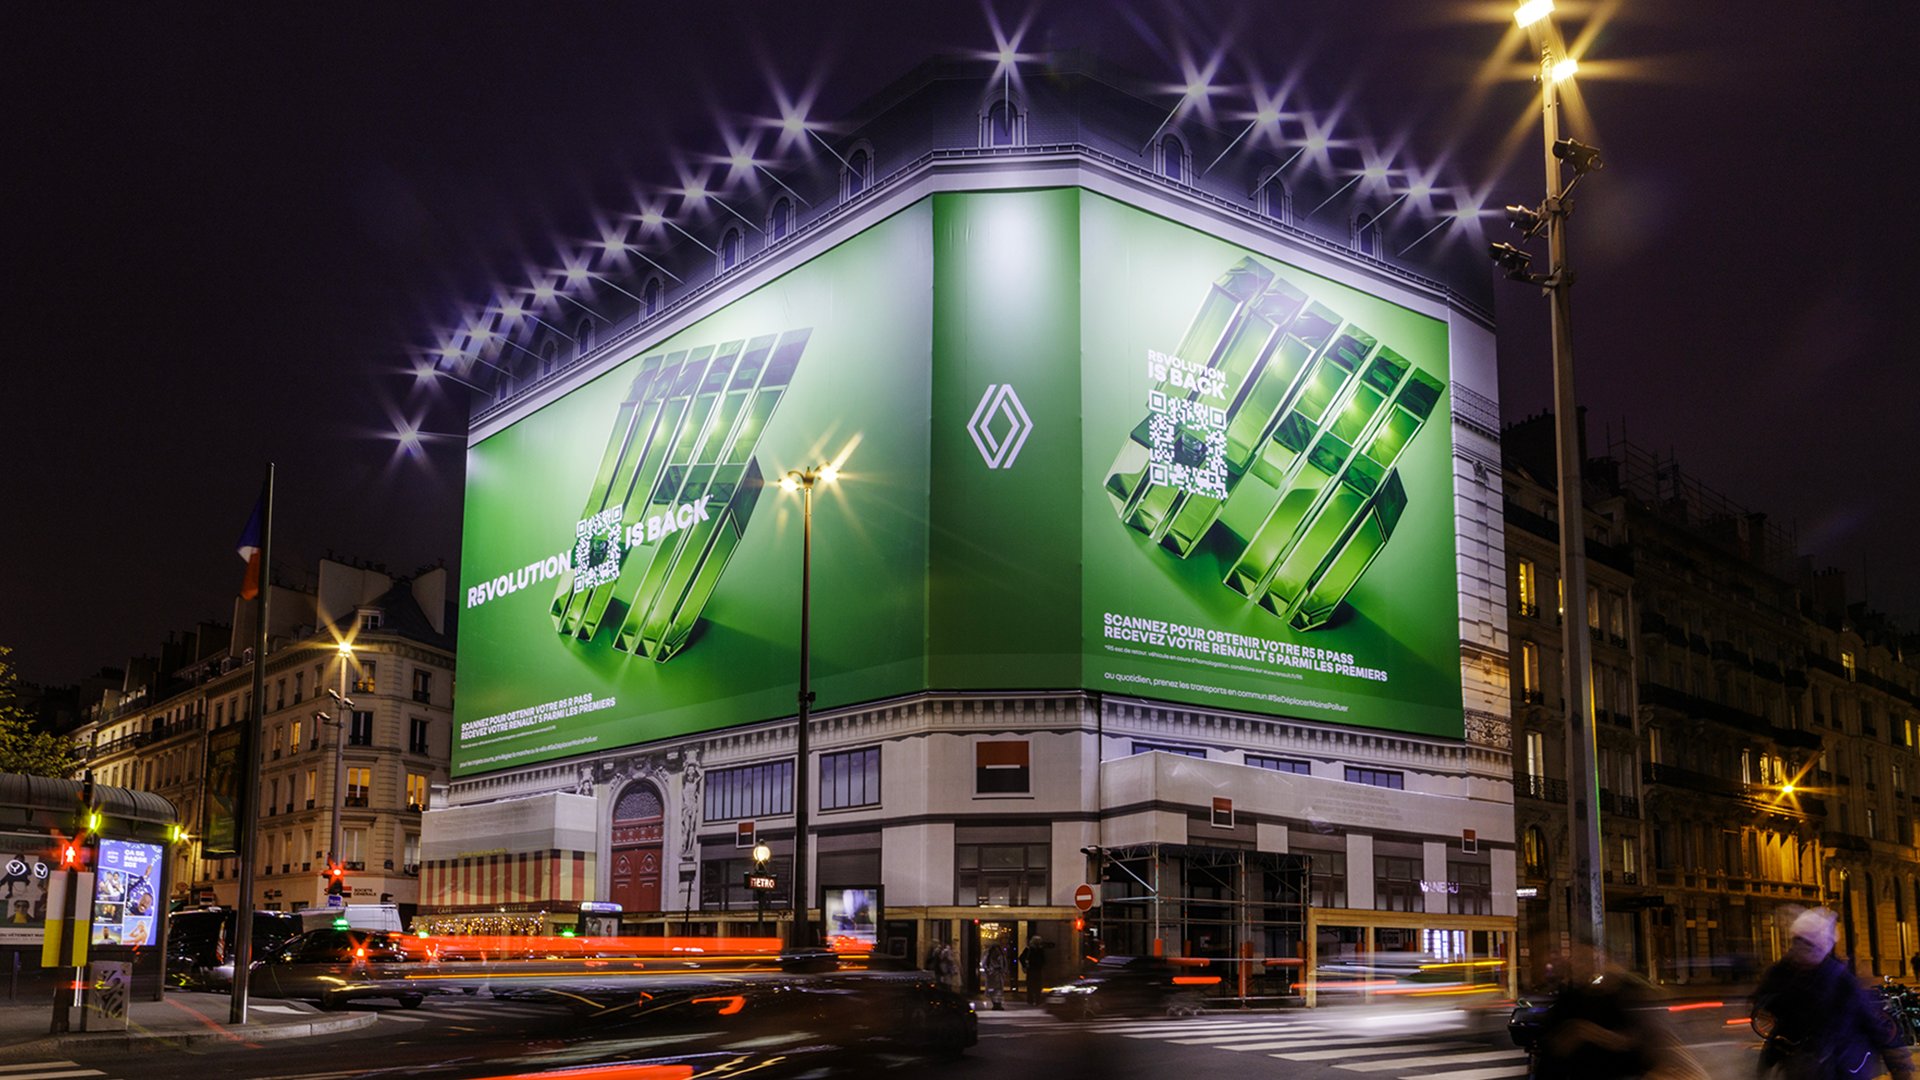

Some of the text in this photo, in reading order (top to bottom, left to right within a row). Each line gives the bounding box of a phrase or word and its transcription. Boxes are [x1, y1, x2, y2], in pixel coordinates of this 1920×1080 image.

[1148, 361, 1167, 382] IS
[467, 550, 572, 608] R5VOLUTION
[625, 523, 644, 550] IS
[1104, 612, 1354, 665] SCANNEZ POUR OBTENIR VOTRE R5 R PASS
[1104, 625, 1388, 682] RECEVEZ VOTRE RENAULT 5 PARMI LES PREMIERS
[1153, 677, 1179, 689] prenez
[1180, 681, 1190, 690] les
[1191, 682, 1227, 695] transports
[461, 718, 489, 731] SCANNEZ
[489, 714, 507, 724] POUR
[507, 707, 534, 720] OBTENIR
[536, 701, 558, 714] VOTRE
[574, 693, 592, 705] PASS
[461, 727, 488, 740] RECEVEZ
[488, 721, 508, 734] VOTRE
[508, 716, 538, 730] RENAULT
[543, 708, 565, 722] PARMI
[565, 705, 578, 717] LES
[578, 697, 616, 714] PREMIERS
